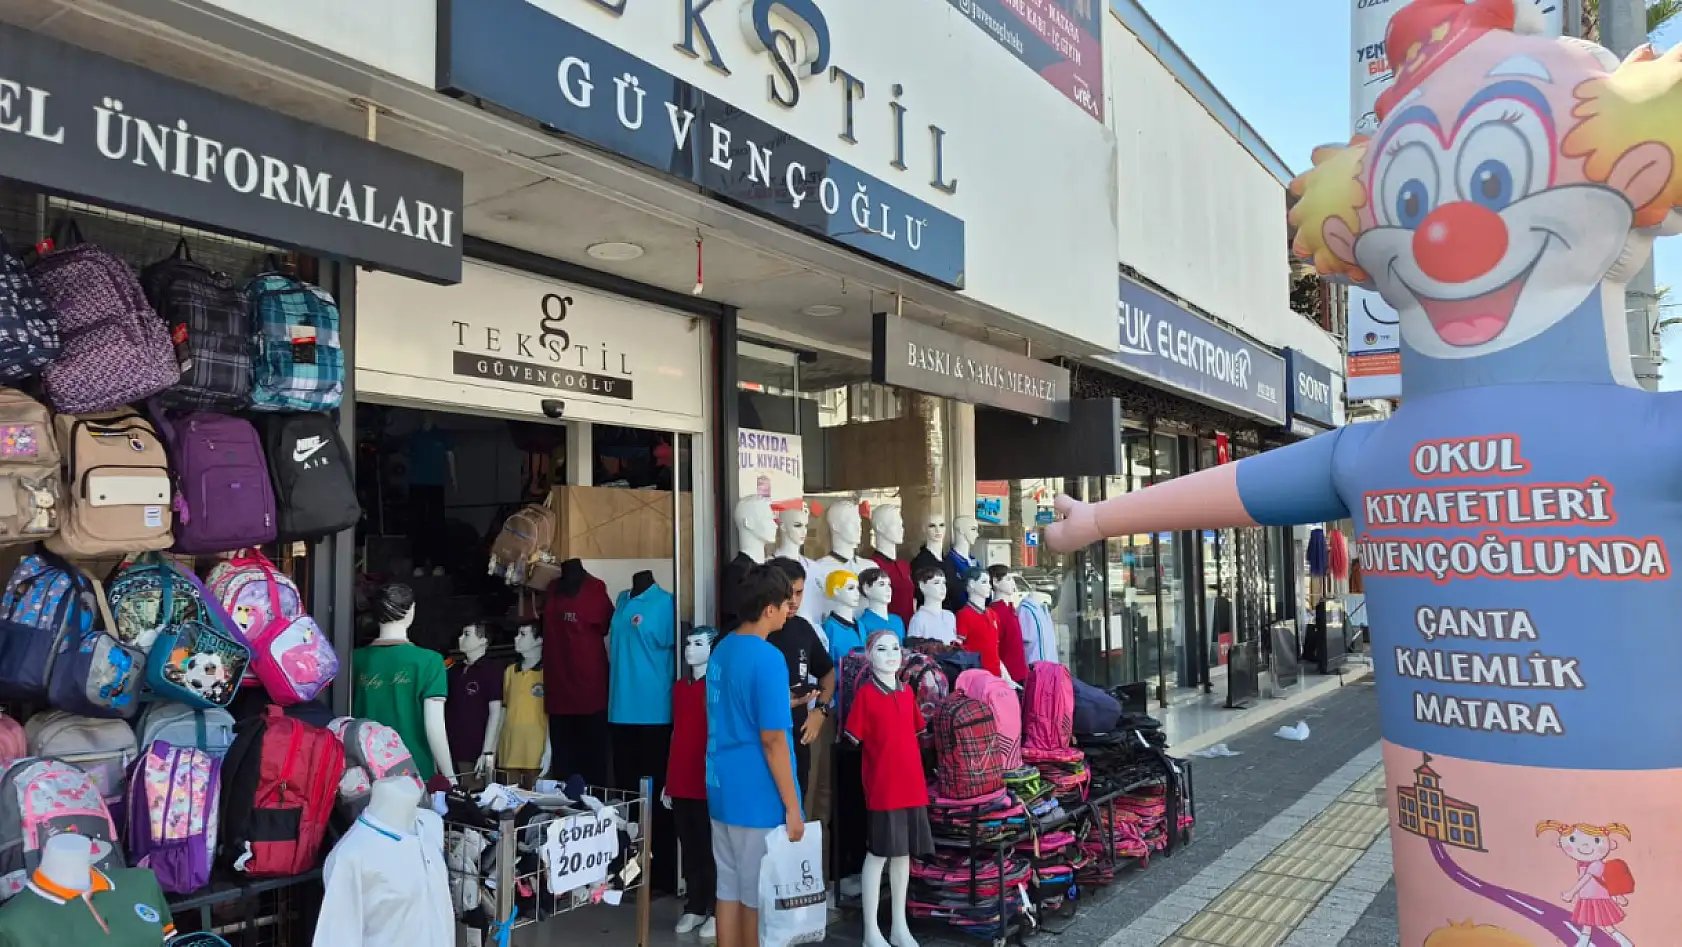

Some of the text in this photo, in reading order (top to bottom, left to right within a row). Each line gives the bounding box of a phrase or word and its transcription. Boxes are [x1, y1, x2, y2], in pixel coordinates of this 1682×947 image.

[93, 97, 454, 247] ÜNİFORMALARI
[558, 56, 924, 250] GÜVENÇOĞLU
[452, 320, 632, 375] TEKSTİL
[908, 341, 951, 375] BASKI
[953, 355, 964, 378] &
[477, 360, 613, 393] GÜVENÇOĞLU
[1298, 371, 1329, 404] SONY
[757, 453, 799, 479] KIYAFETİ
[1414, 437, 1524, 474] OKUL
[1364, 480, 1612, 524] KIYAFETLERİ
[1415, 606, 1538, 640] ÇANTA
[1394, 646, 1585, 689] KALEMLİK
[1414, 692, 1564, 735] MATARA
